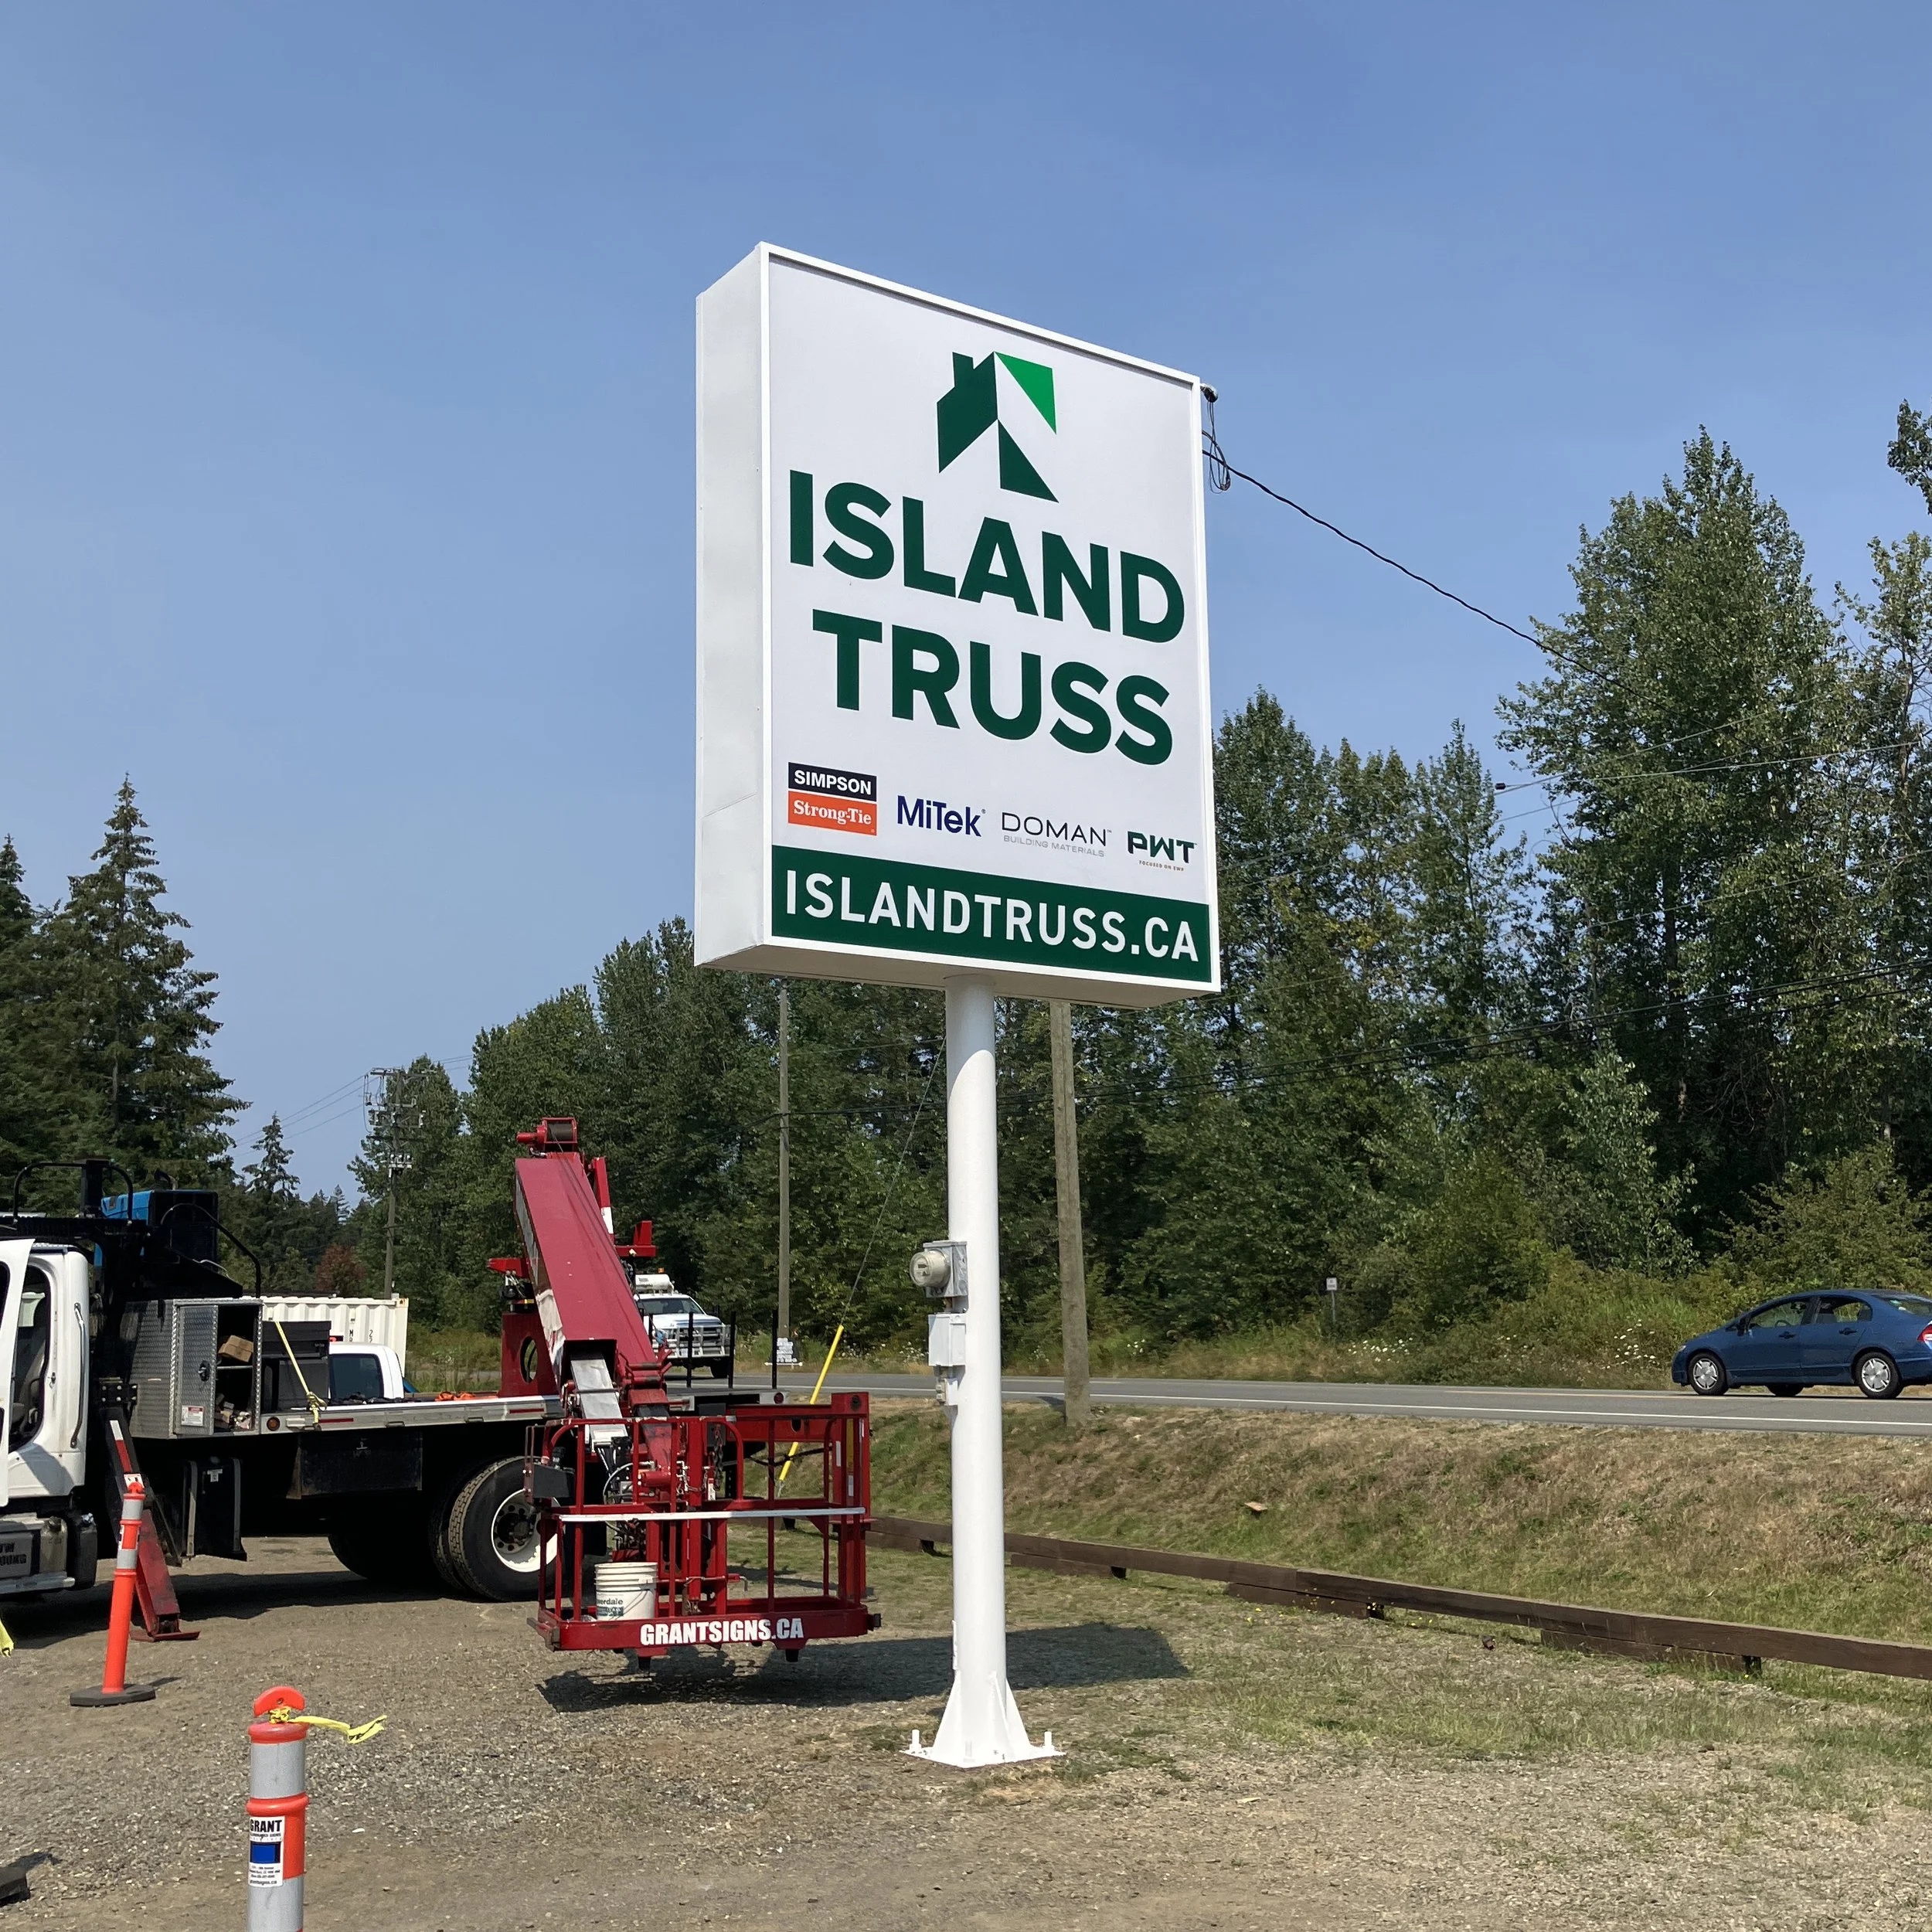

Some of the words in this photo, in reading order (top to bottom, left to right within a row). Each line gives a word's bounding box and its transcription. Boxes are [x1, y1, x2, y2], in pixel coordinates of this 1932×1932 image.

[790, 470, 1185, 643] ISLAND
[812, 609, 1173, 765] TRUSS
[794, 770, 872, 795] SIMPSON
[793, 799, 872, 825] Strong-Tie
[897, 795, 981, 837] MiTek
[1002, 812, 1107, 847] DOMAN
[1003, 835, 1049, 848] BUILDING
[1051, 842, 1104, 857] MATERIALS
[1128, 831, 1194, 863] PWT
[787, 870, 1199, 962] ISLANDTRUSS.CA
[640, 1617, 804, 1646] GRANTSIGNS.CA
[250, 1819, 282, 1832] GRANT
